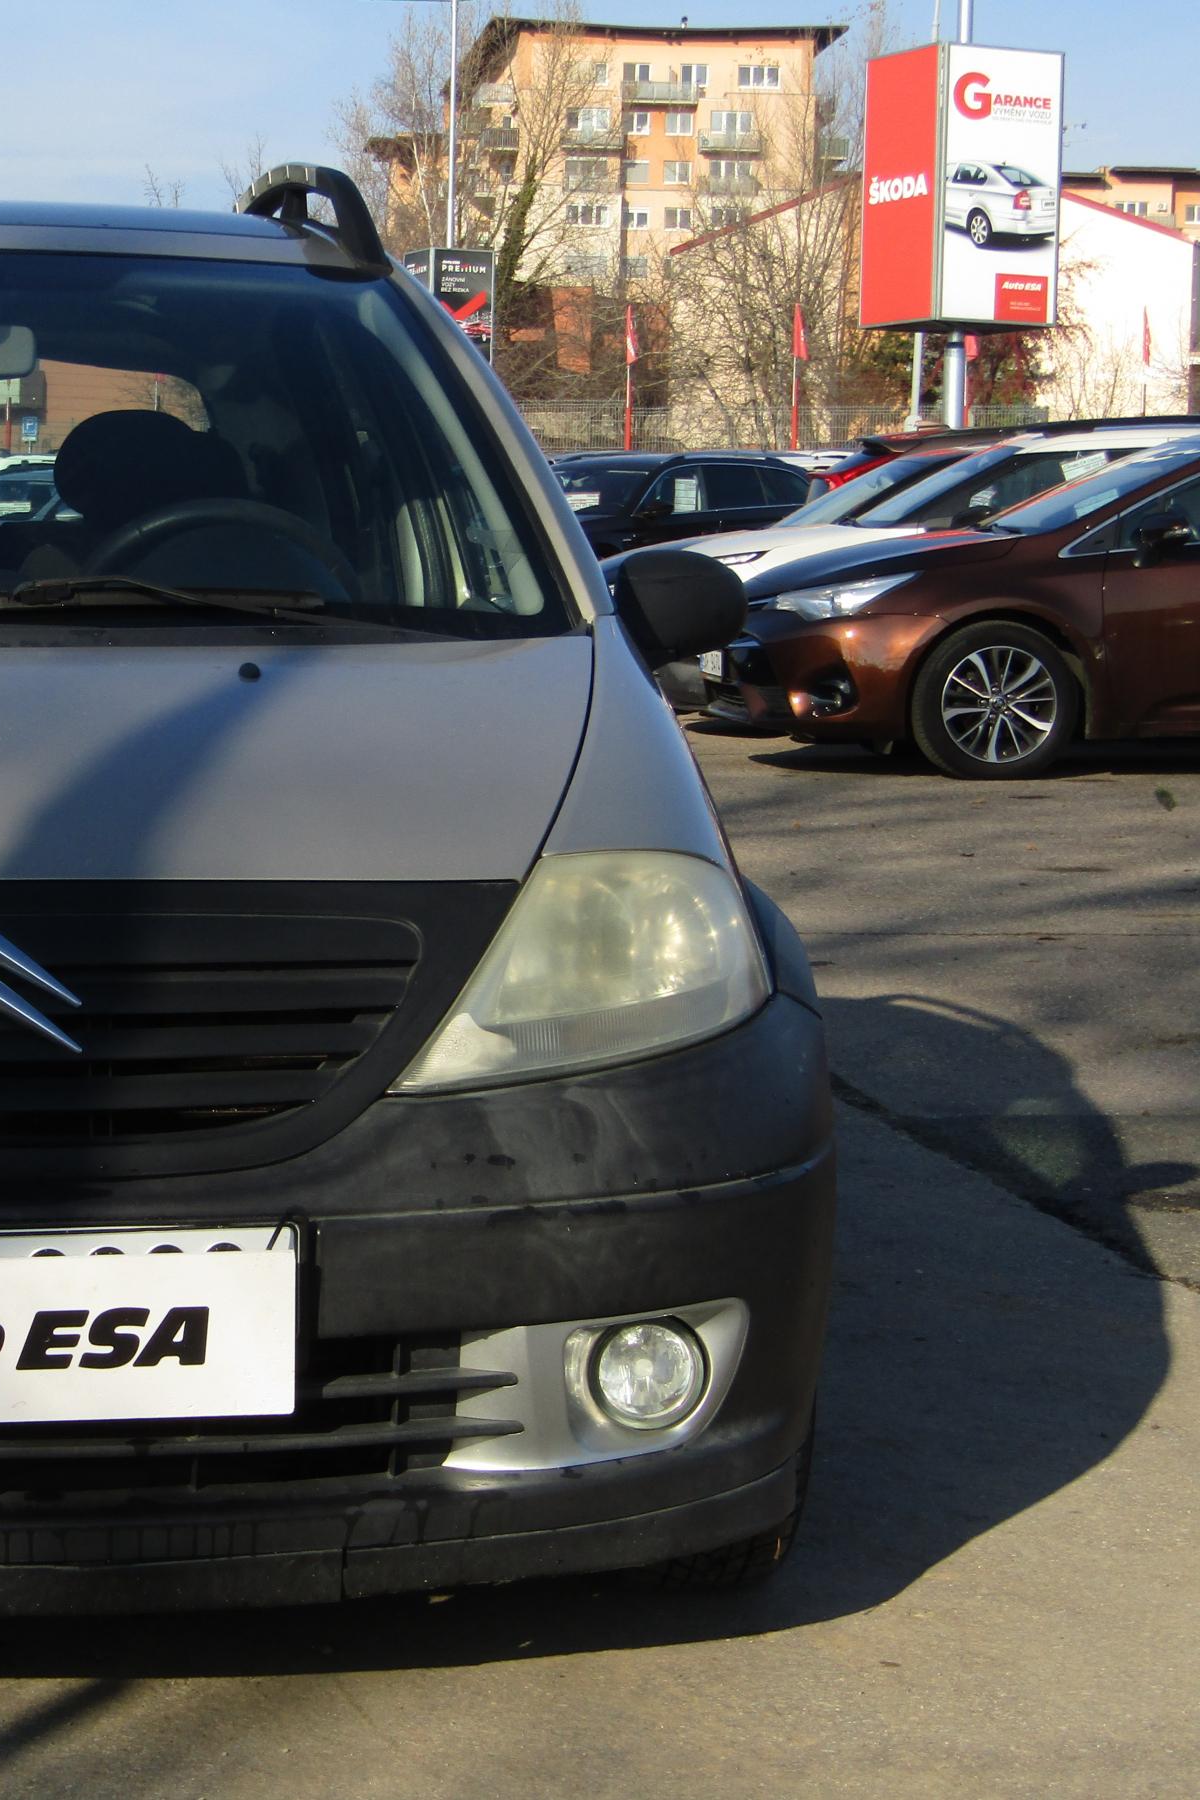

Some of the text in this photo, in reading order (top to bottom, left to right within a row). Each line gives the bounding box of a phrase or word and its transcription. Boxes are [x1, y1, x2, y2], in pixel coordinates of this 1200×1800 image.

[953, 71, 1052, 120] GARANCE
[868, 173, 928, 205] ŠKODA
[442, 264, 486, 273] PREMIUM
[1025, 282, 1042, 292] ESA
[16, 1306, 210, 1372] ESA
